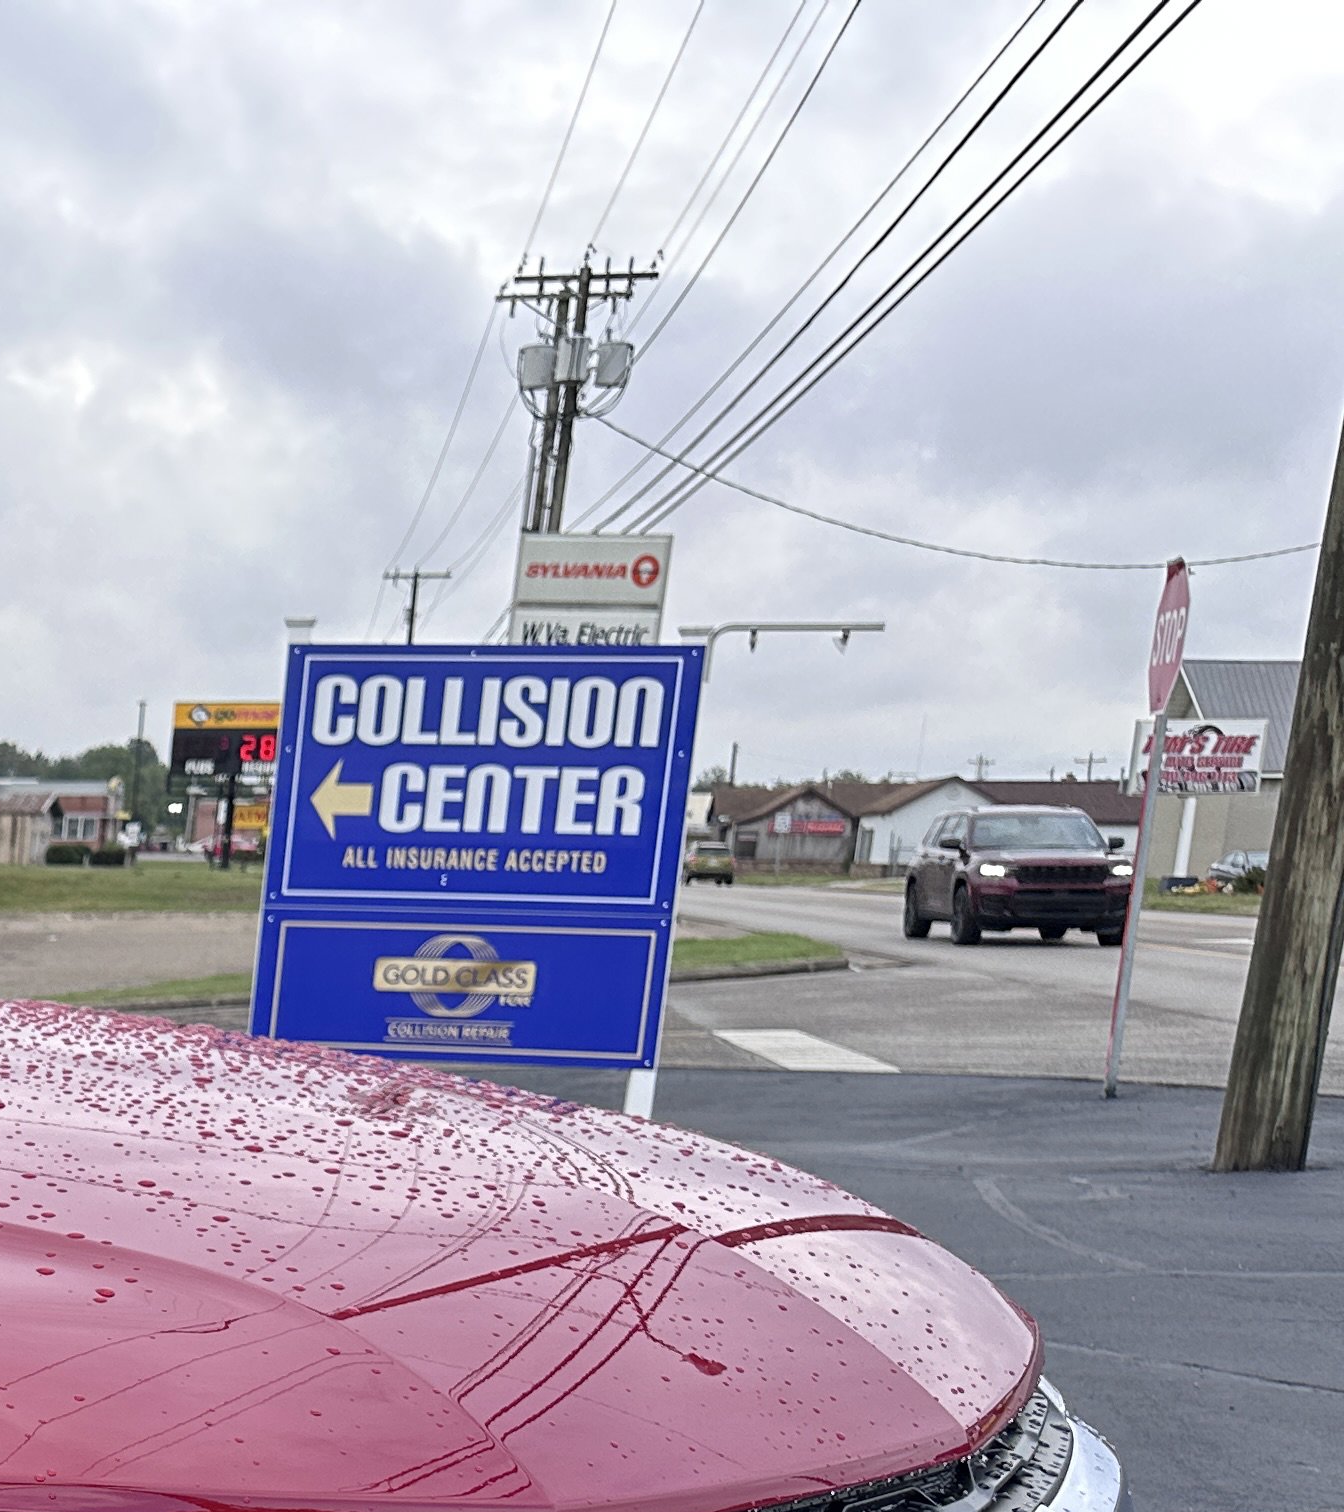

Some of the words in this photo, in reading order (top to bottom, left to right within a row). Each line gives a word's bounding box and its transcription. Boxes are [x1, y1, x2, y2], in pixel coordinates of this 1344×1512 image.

[525, 561, 628, 580] SYLVANIA
[1152, 607, 1187, 667] STOP
[312, 674, 664, 748] COLLISION
[378, 762, 646, 835] CENTER
[342, 846, 378, 869] ALL
[386, 847, 499, 871] INSURANCE
[504, 849, 607, 874] ACCEPTED
[382, 964, 450, 986] GOLD
[455, 966, 529, 989] CLASS
